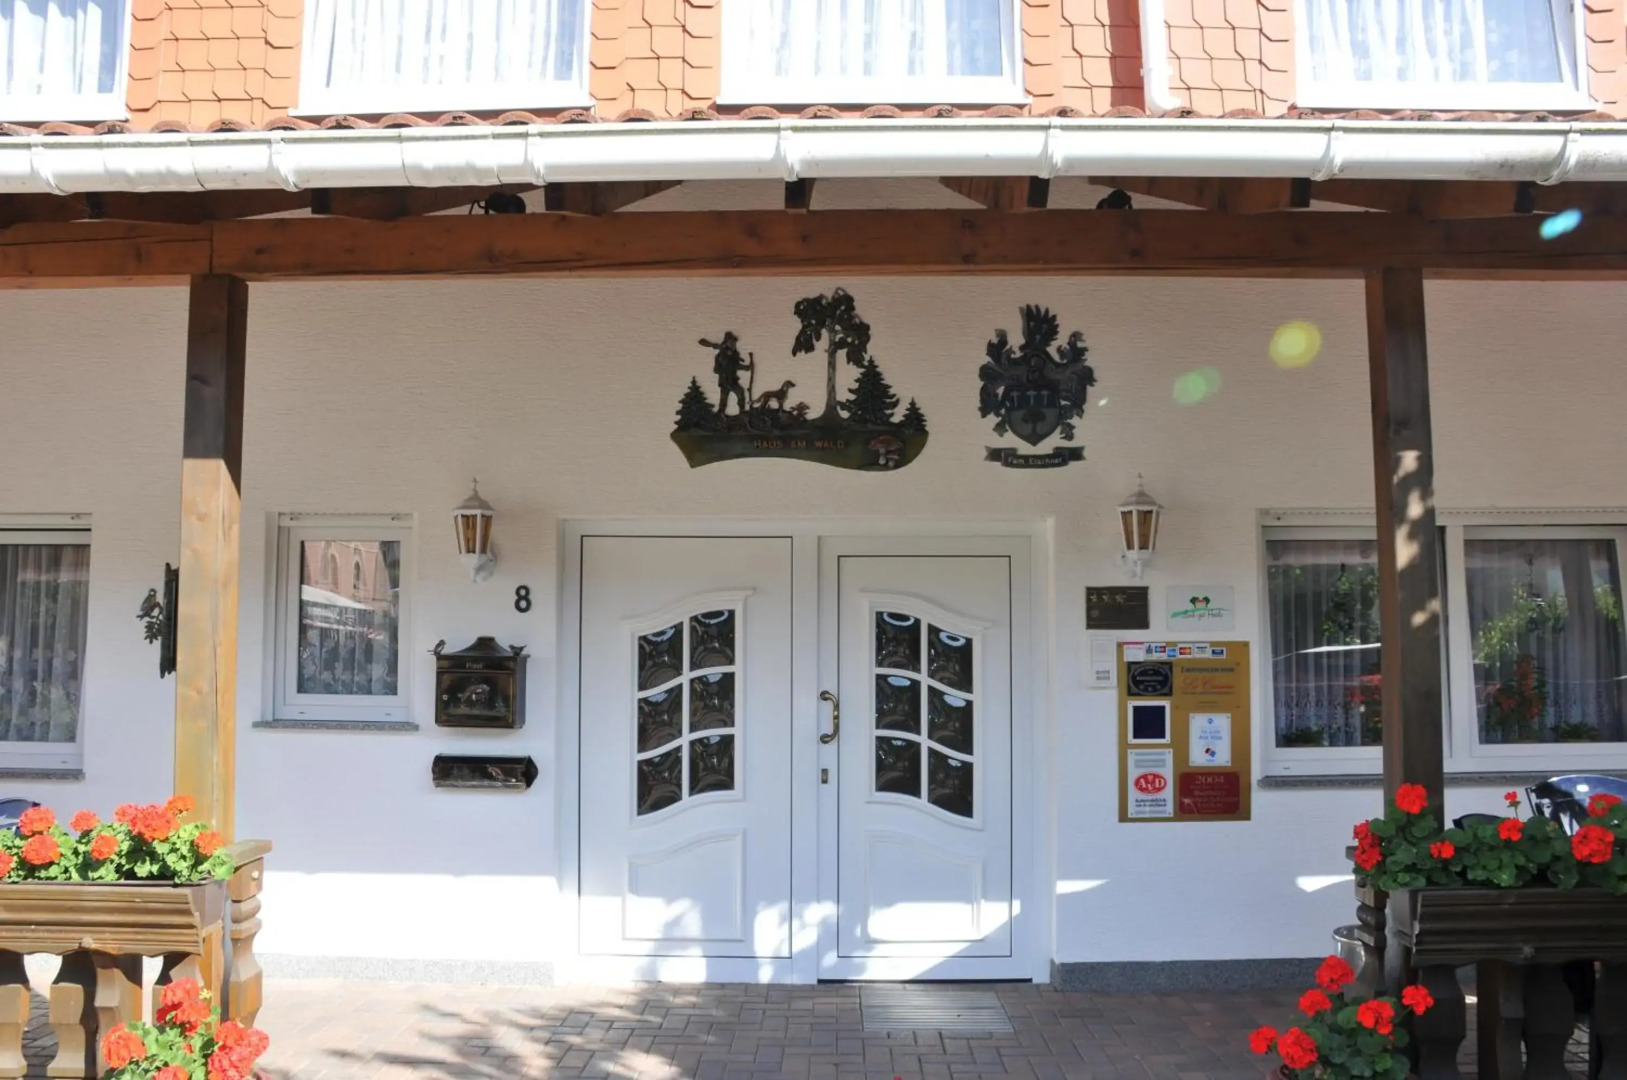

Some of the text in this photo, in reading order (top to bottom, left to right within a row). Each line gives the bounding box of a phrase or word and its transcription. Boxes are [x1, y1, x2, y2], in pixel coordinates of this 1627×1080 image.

[754, 439, 845, 449] HAUS AM WALD
[515, 586, 531, 613] 8
[1195, 775, 1224, 784] 2004
